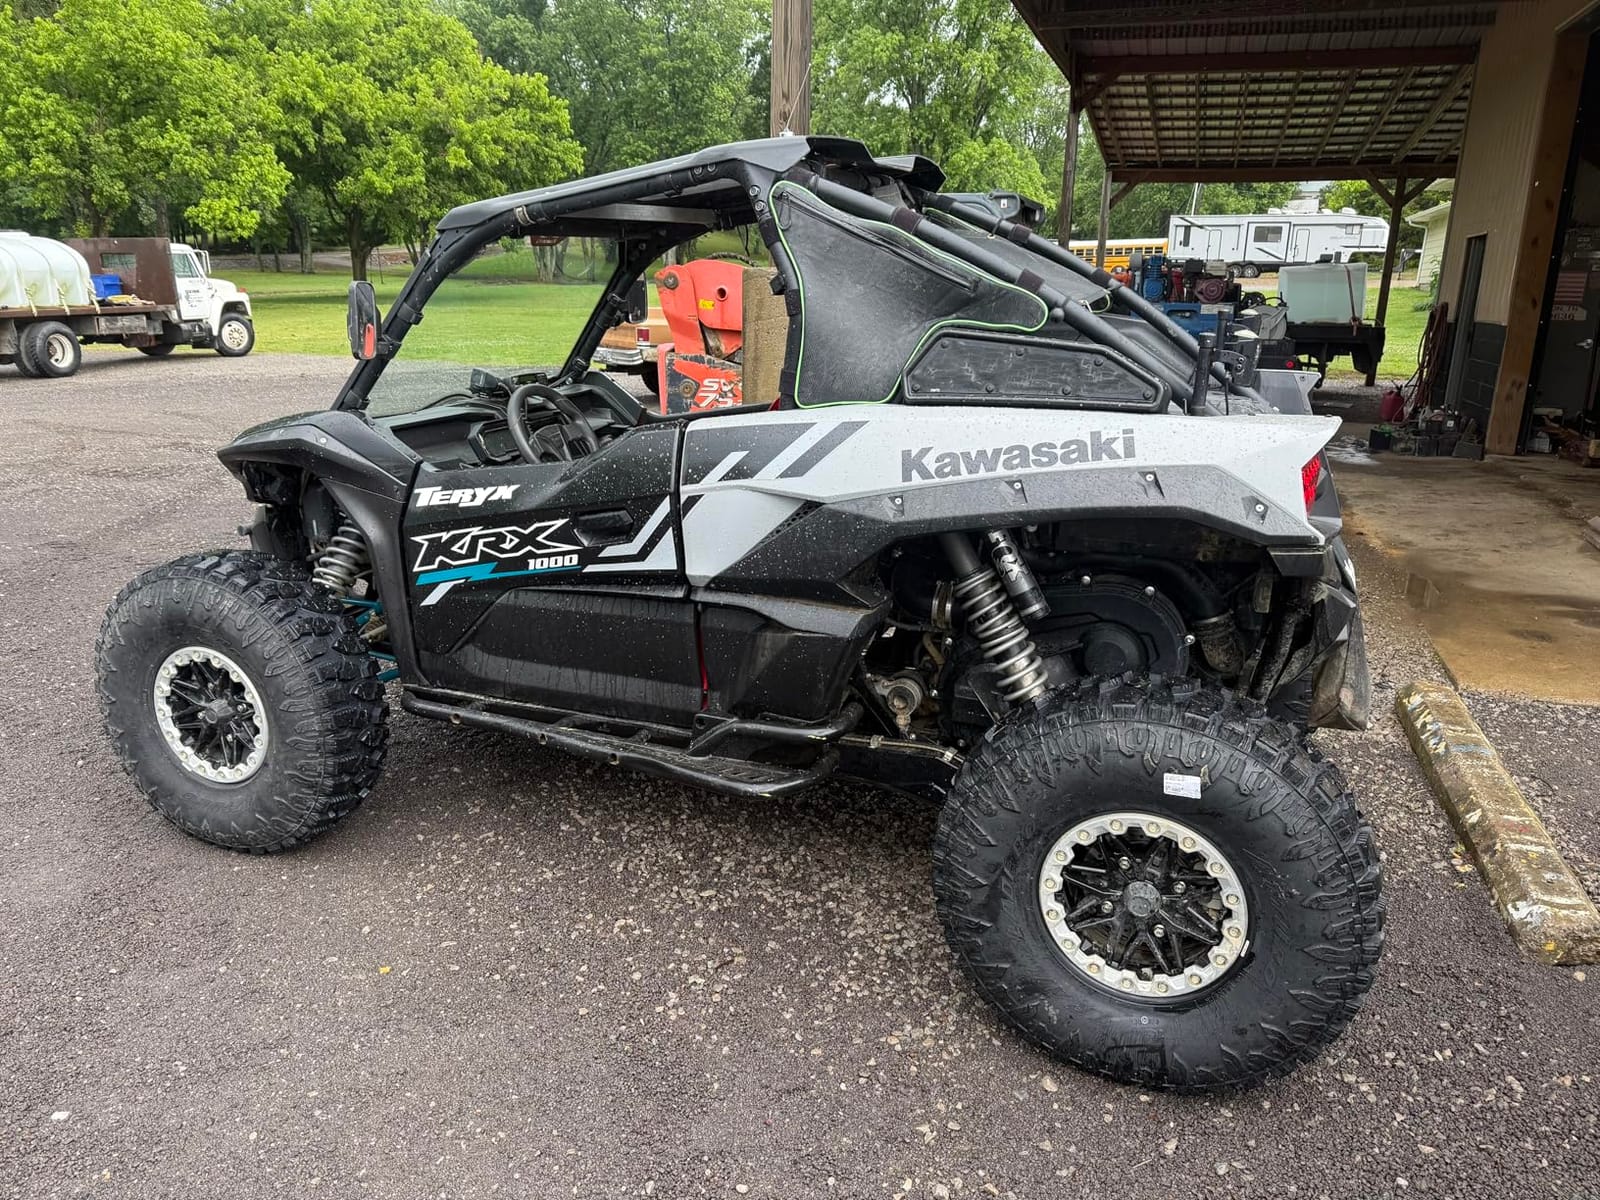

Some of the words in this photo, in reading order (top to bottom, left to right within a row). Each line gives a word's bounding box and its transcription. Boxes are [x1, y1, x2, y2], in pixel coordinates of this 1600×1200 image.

[901, 428, 1136, 483] Kawasaki
[410, 518, 584, 572] KRX
[527, 554, 579, 570] 1000
